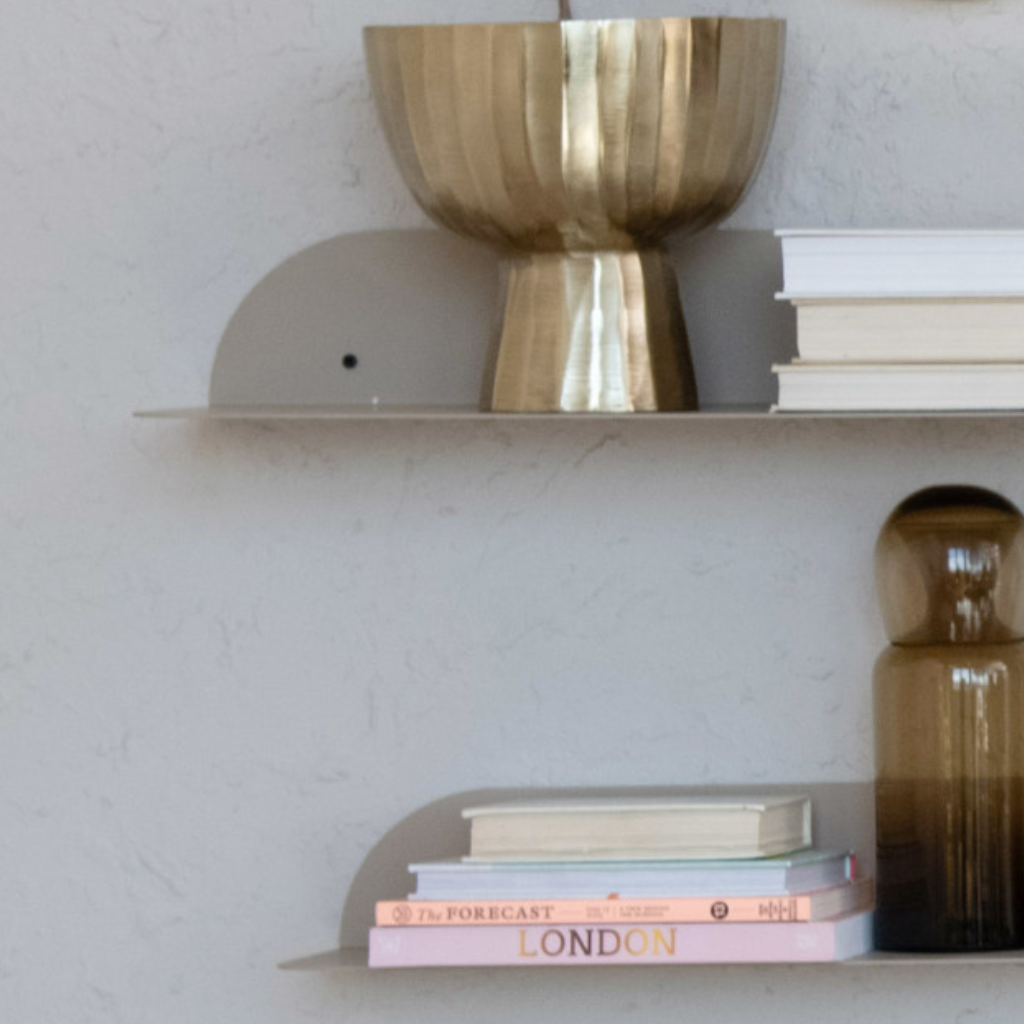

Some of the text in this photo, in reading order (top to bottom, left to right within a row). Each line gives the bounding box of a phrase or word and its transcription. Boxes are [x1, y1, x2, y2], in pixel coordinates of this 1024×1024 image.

[417, 905, 555, 921] The FORECAST
[518, 927, 677, 958] LONDON
